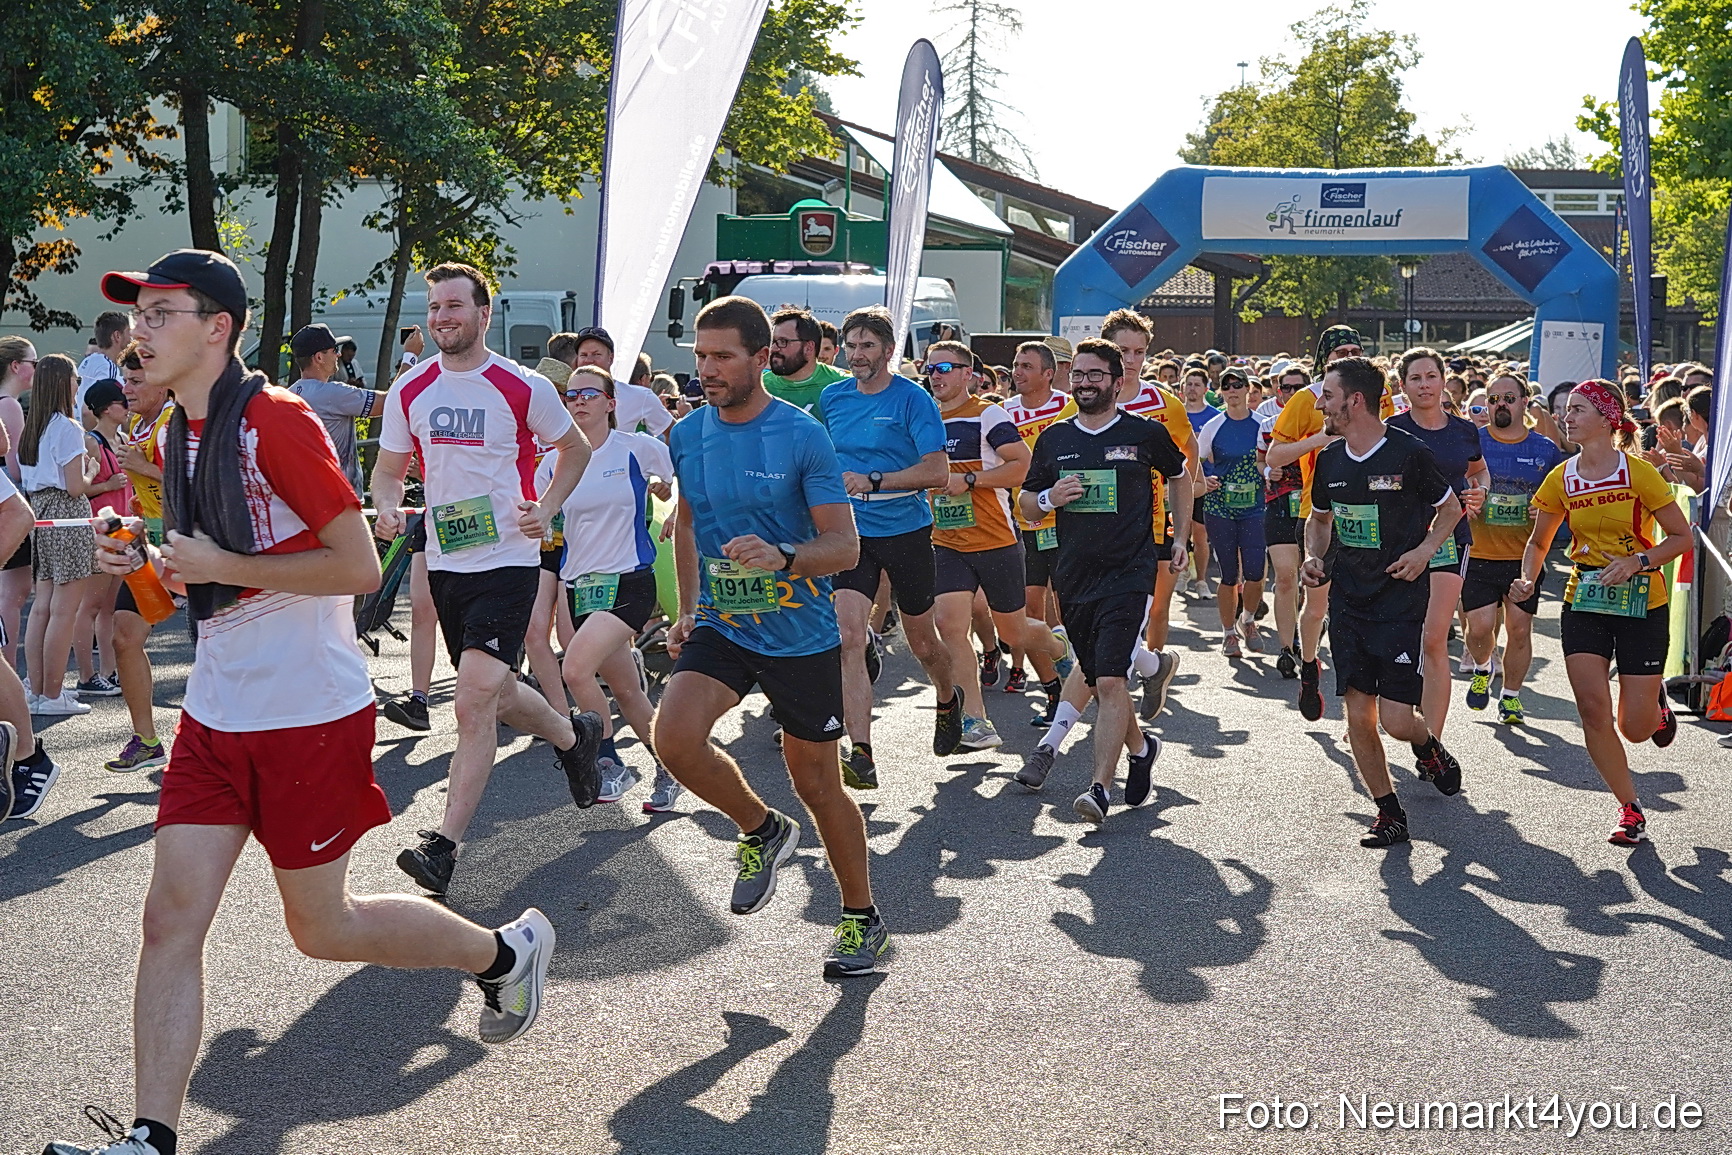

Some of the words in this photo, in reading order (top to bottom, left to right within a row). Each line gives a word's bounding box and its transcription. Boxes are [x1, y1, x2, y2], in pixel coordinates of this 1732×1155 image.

[1330, 191, 1364, 200] Fischer
[1304, 208, 1404, 228] firmenlauf
[1113, 239, 1168, 251] Fischer
[1118, 249, 1163, 257] AUTOMOBILE
[1499, 242, 1515, 252] und
[1515, 240, 1530, 249] das
[755, 471, 787, 480] PLAST
[1233, 491, 1250, 500] 711
[1569, 497, 1595, 511] MAX
[1597, 491, 1634, 506] BÖGL
[938, 505, 967, 519] 1822
[1496, 505, 1520, 516] 644
[447, 514, 479, 537] 504
[484, 514, 495, 537] 2022
[1341, 518, 1363, 534] 421
[1369, 522, 1377, 543] 2022
[438, 527, 446, 545] RUN
[581, 584, 605, 601] 316
[608, 586, 616, 605] 2022
[710, 581, 719, 601] RUN
[716, 576, 765, 597] 1914
[764, 578, 776, 604] 2022
[1587, 583, 1618, 601] 816
[737, 596, 765, 606] Jochen
[1621, 589, 1630, 610] 2022
